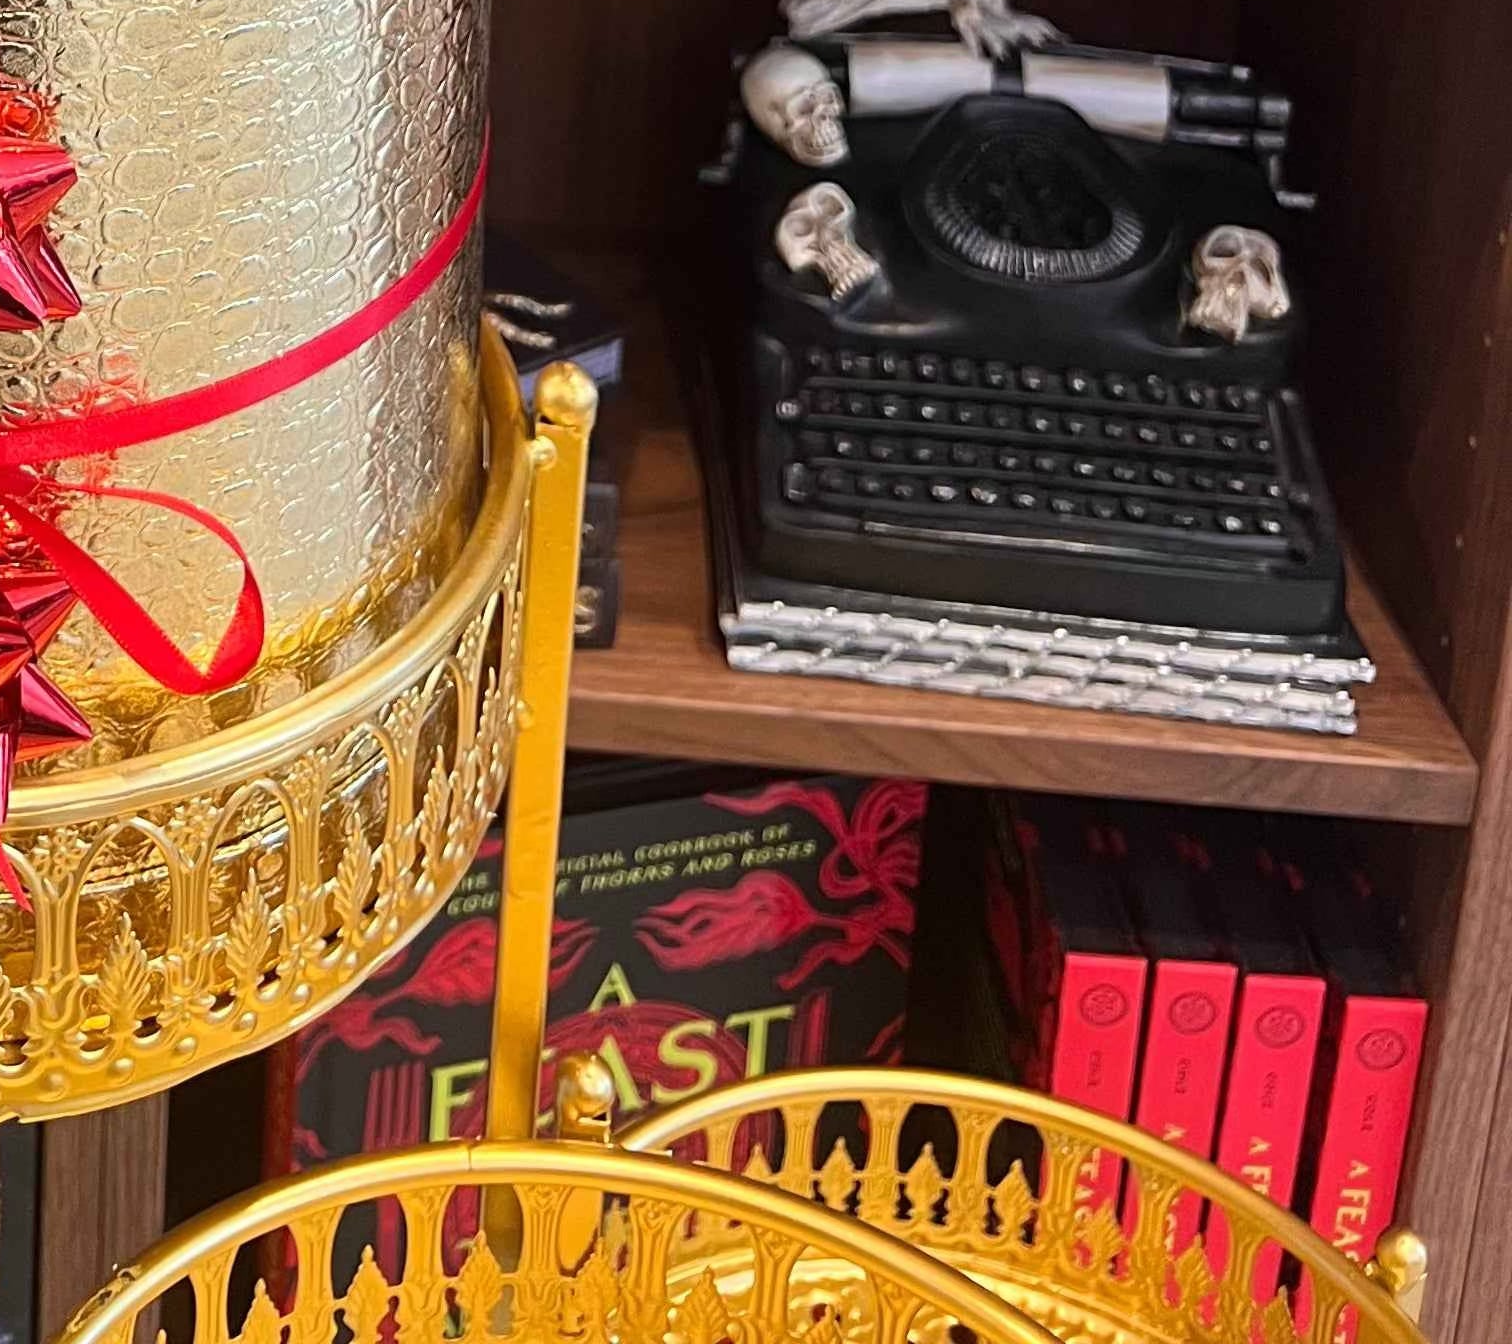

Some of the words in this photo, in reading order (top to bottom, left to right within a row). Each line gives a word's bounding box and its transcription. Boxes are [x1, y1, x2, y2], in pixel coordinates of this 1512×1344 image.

[681, 852, 736, 877] AND
[740, 840, 818, 868] ROSES
[589, 961, 637, 1012] A
[429, 1005, 796, 1144] FAST
